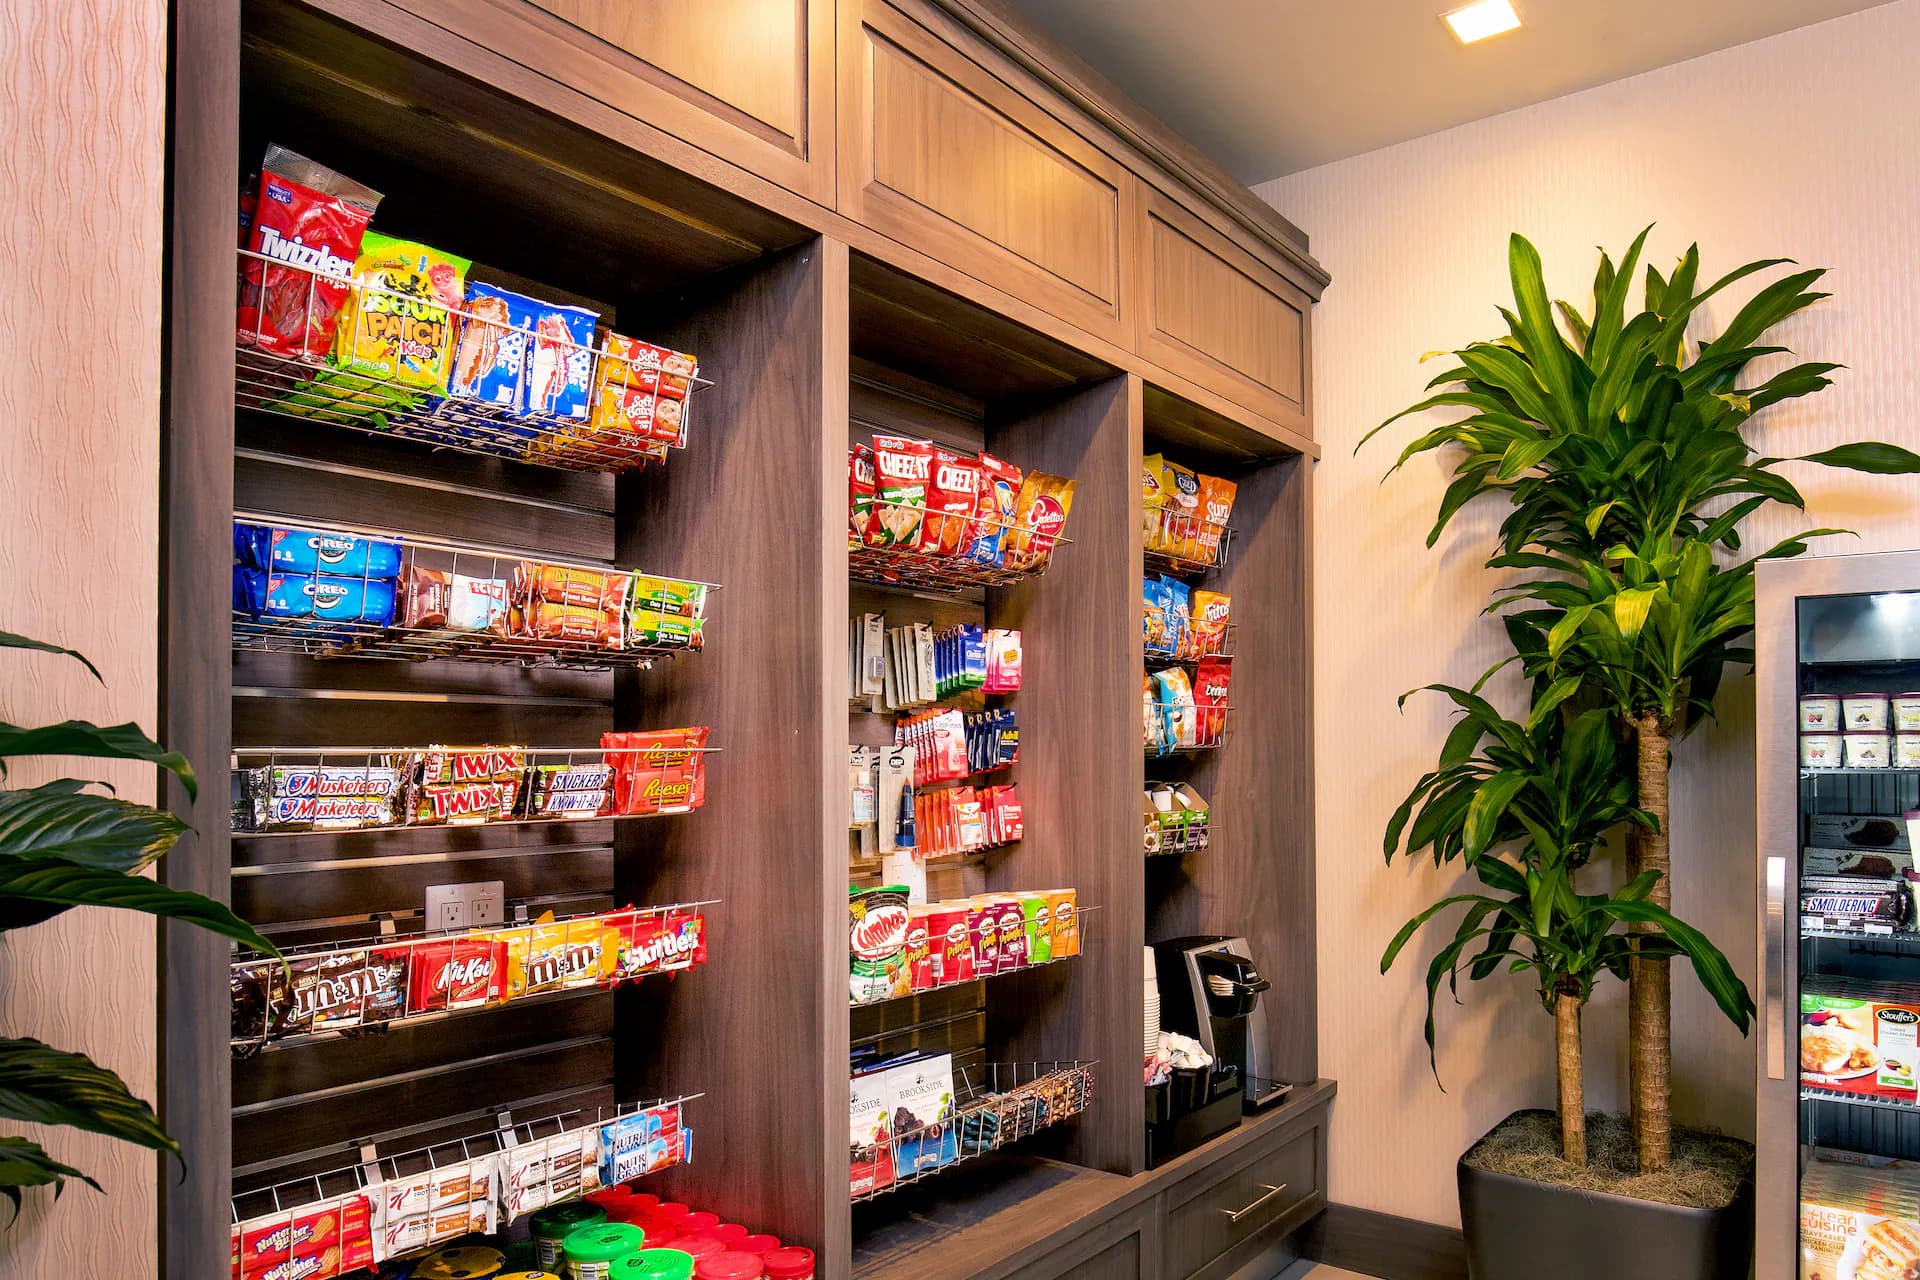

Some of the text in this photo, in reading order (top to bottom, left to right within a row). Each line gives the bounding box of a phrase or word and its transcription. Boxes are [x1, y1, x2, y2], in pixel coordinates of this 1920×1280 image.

[367, 312, 448, 347] PATCH
[401, 340, 432, 358] Kids
[879, 450, 933, 480] CHEEZ-IT
[307, 537, 354, 551] OREO
[302, 584, 349, 597] OREO
[1206, 603, 1230, 622] Fritos
[303, 776, 389, 795] Musketeers
[553, 773, 607, 789] SNICKERS
[643, 778, 692, 798] Reese's
[295, 799, 379, 818] Musketeers
[1809, 897, 1877, 913] SMOLDERING
[624, 932, 699, 973] Skittles
[1880, 1010, 1915, 1023] Stouffer's
[900, 1080, 945, 1100] BROOKSIDE
[850, 1097, 881, 1115] OKSIDE
[256, 1226, 293, 1254] Nutter
[275, 1225, 310, 1251] Buter
